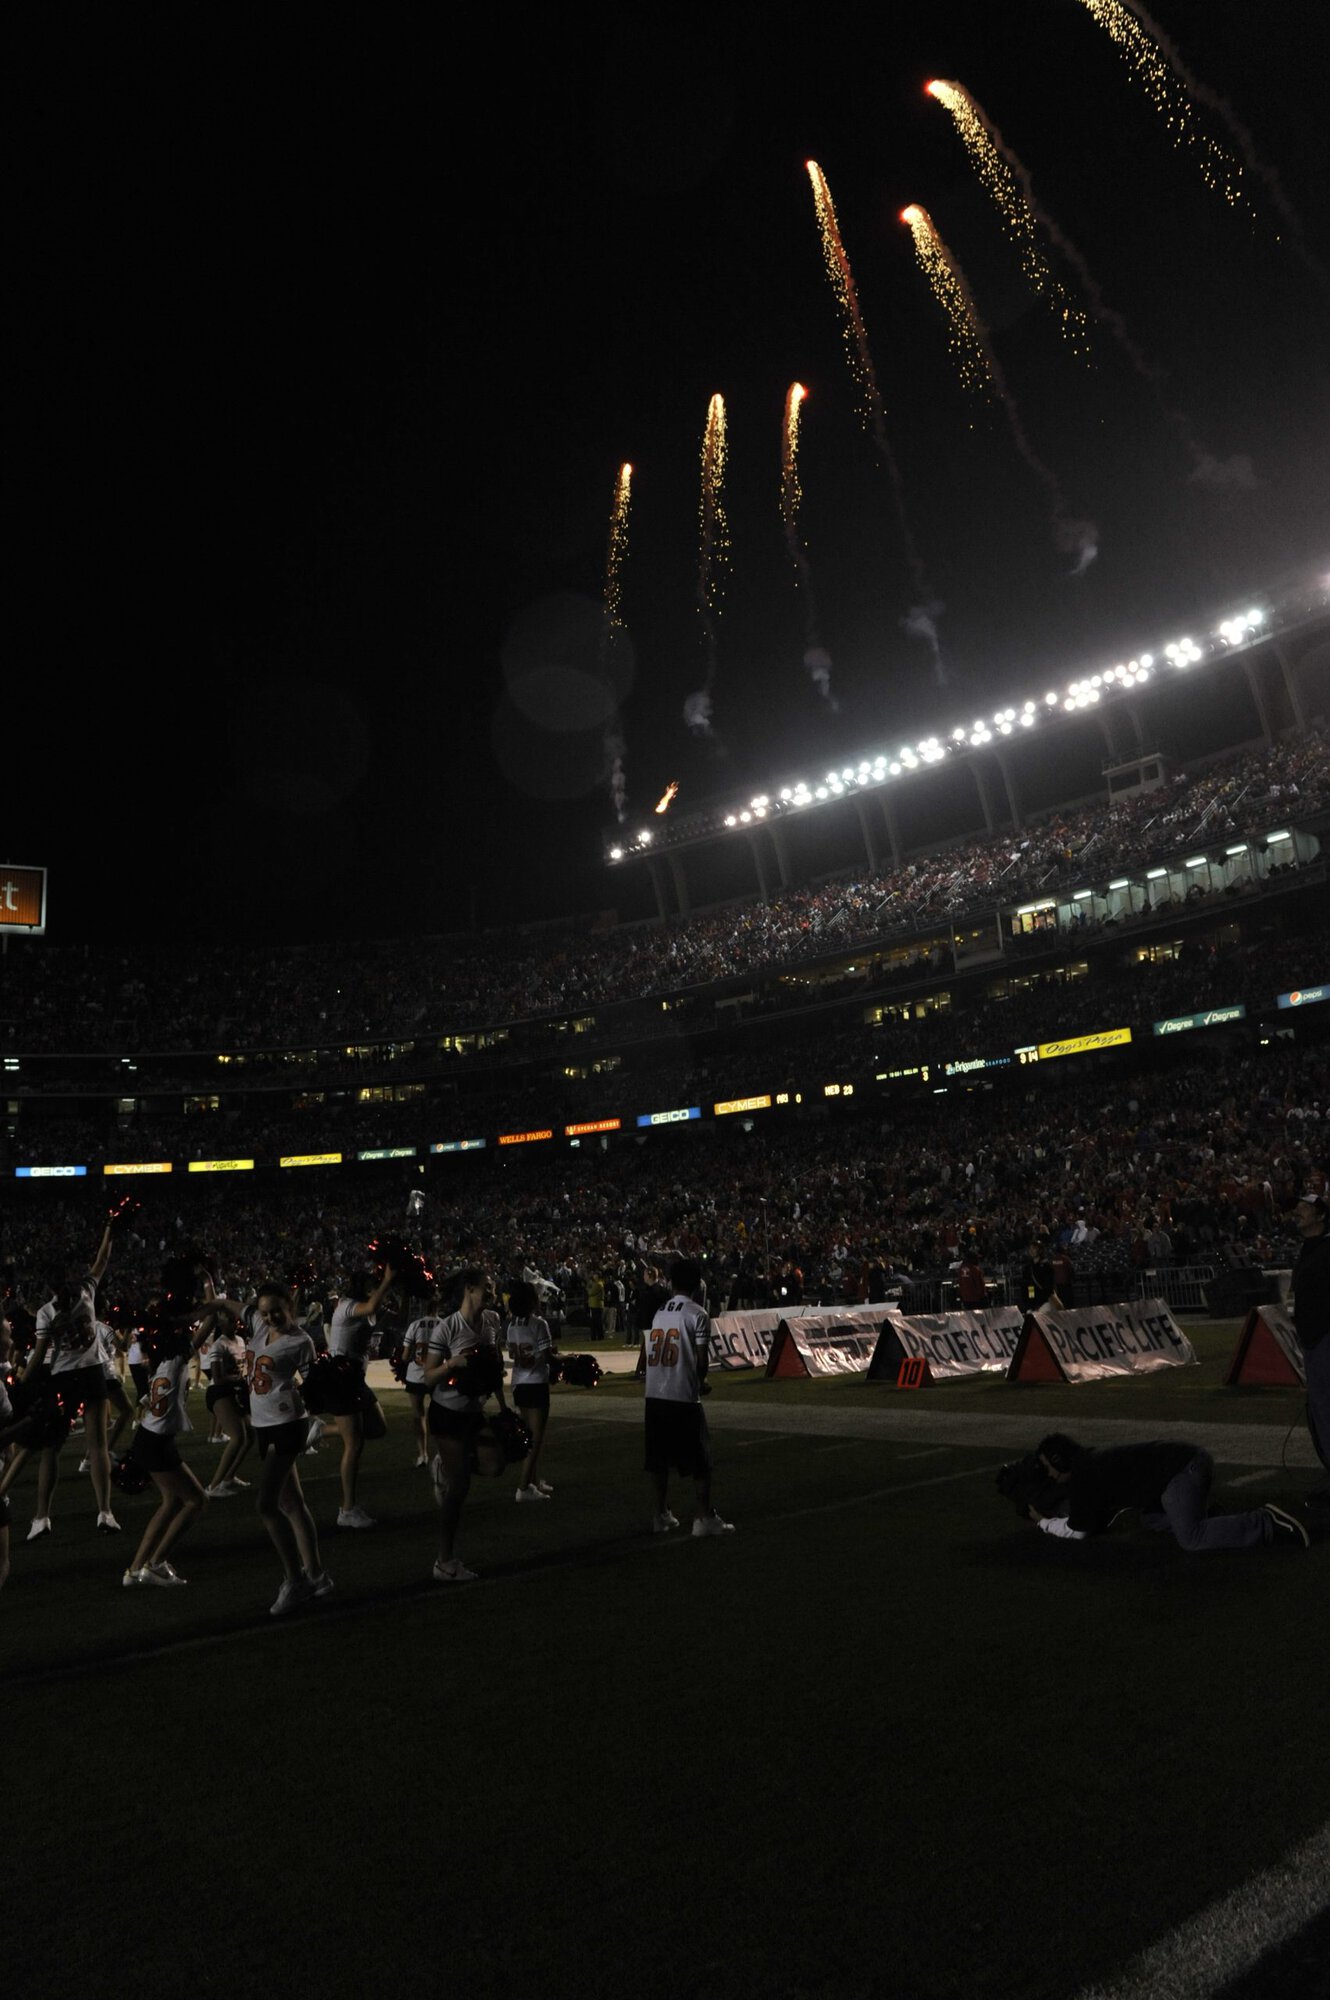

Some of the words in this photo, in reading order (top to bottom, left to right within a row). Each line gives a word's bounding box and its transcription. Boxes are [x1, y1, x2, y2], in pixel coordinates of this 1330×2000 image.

[1302, 990, 1322, 1002] pepsi
[1212, 1010, 1240, 1023] Degree
[1167, 1019, 1193, 1032] Degree
[718, 1096, 767, 1114] CYMER
[650, 1109, 690, 1125] GEICO
[499, 1134, 526, 1144] WELLS
[526, 1131, 552, 1142] FARGO
[30, 1166, 76, 1177] GEICO
[112, 1164, 164, 1175] CYMER
[1046, 1320, 1138, 1364] PACIFIC
[1126, 1313, 1183, 1353] LIFE
[648, 1328, 680, 1367] 36
[903, 1328, 991, 1365] PACIFIC
[901, 1361, 920, 1386] 10
